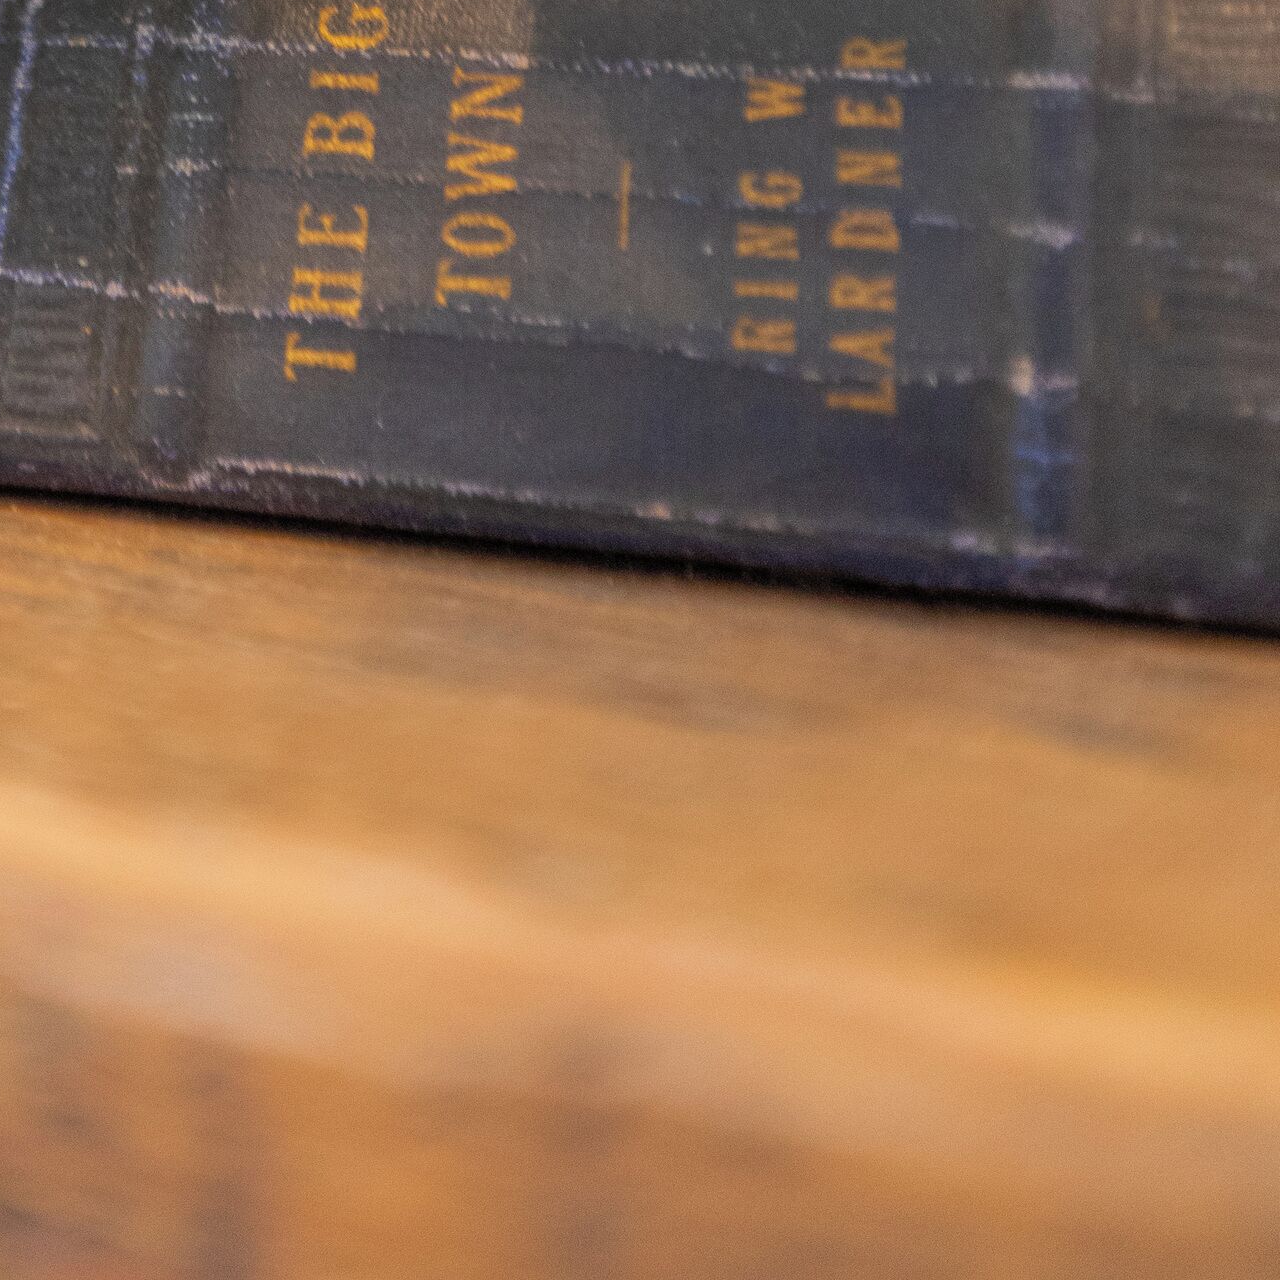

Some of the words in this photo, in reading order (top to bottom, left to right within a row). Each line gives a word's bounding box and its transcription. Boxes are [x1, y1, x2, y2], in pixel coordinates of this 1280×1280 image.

[303, 4, 390, 161] BIG
[743, 74, 807, 123] W
[435, 67, 524, 307] TOWN
[731, 169, 805, 354] RING
[826, 37, 908, 416] LARDNER
[284, 204, 370, 382] THE
